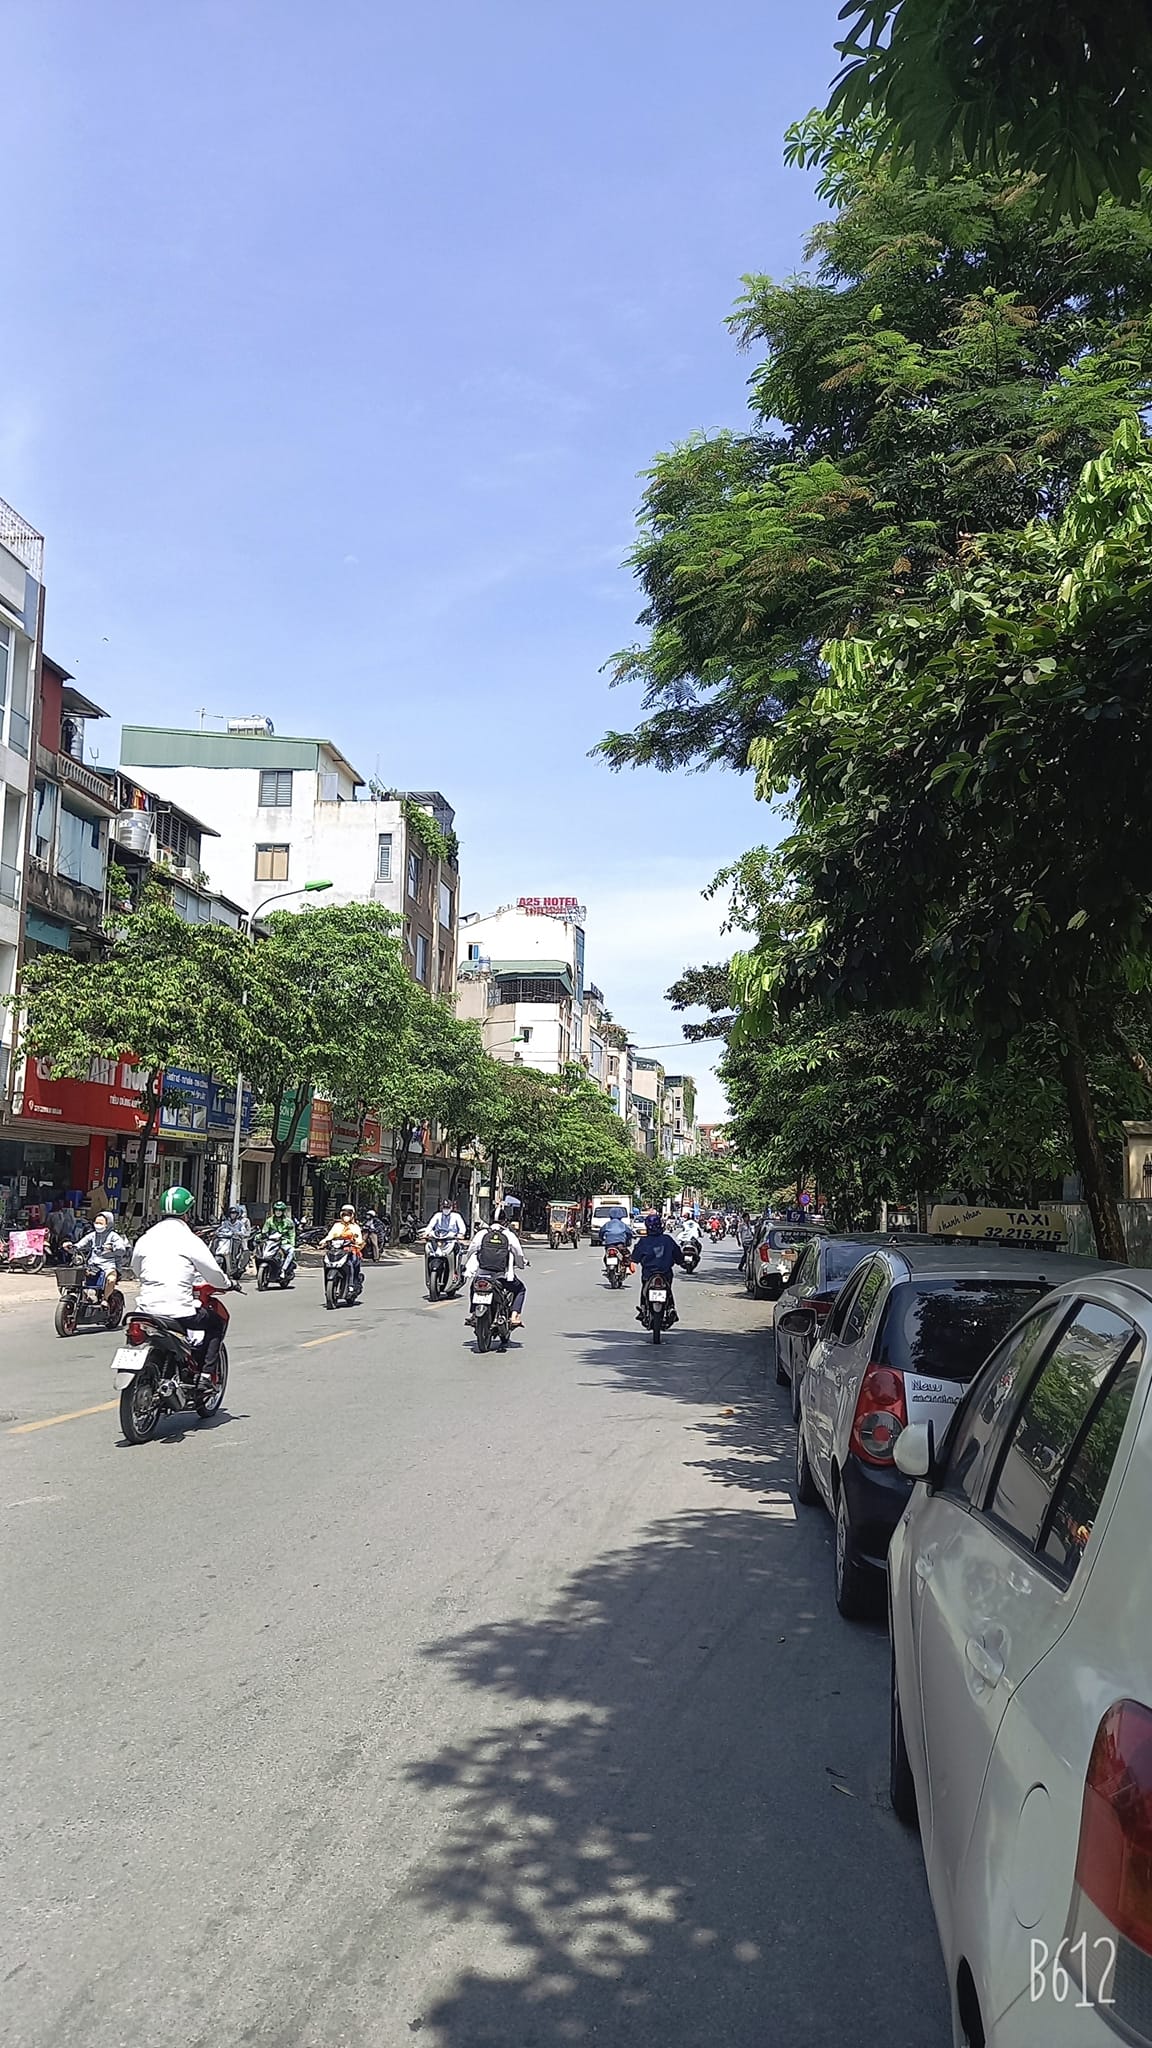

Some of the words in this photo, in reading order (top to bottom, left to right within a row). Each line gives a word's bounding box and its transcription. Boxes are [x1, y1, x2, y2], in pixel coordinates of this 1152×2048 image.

[519, 897, 540, 906] A25
[543, 897, 578, 906] HOTEL
[1006, 1213, 1049, 1226] TAXI
[985, 1227, 1062, 1240] 32.215.215
[912, 1380, 943, 1392] New
